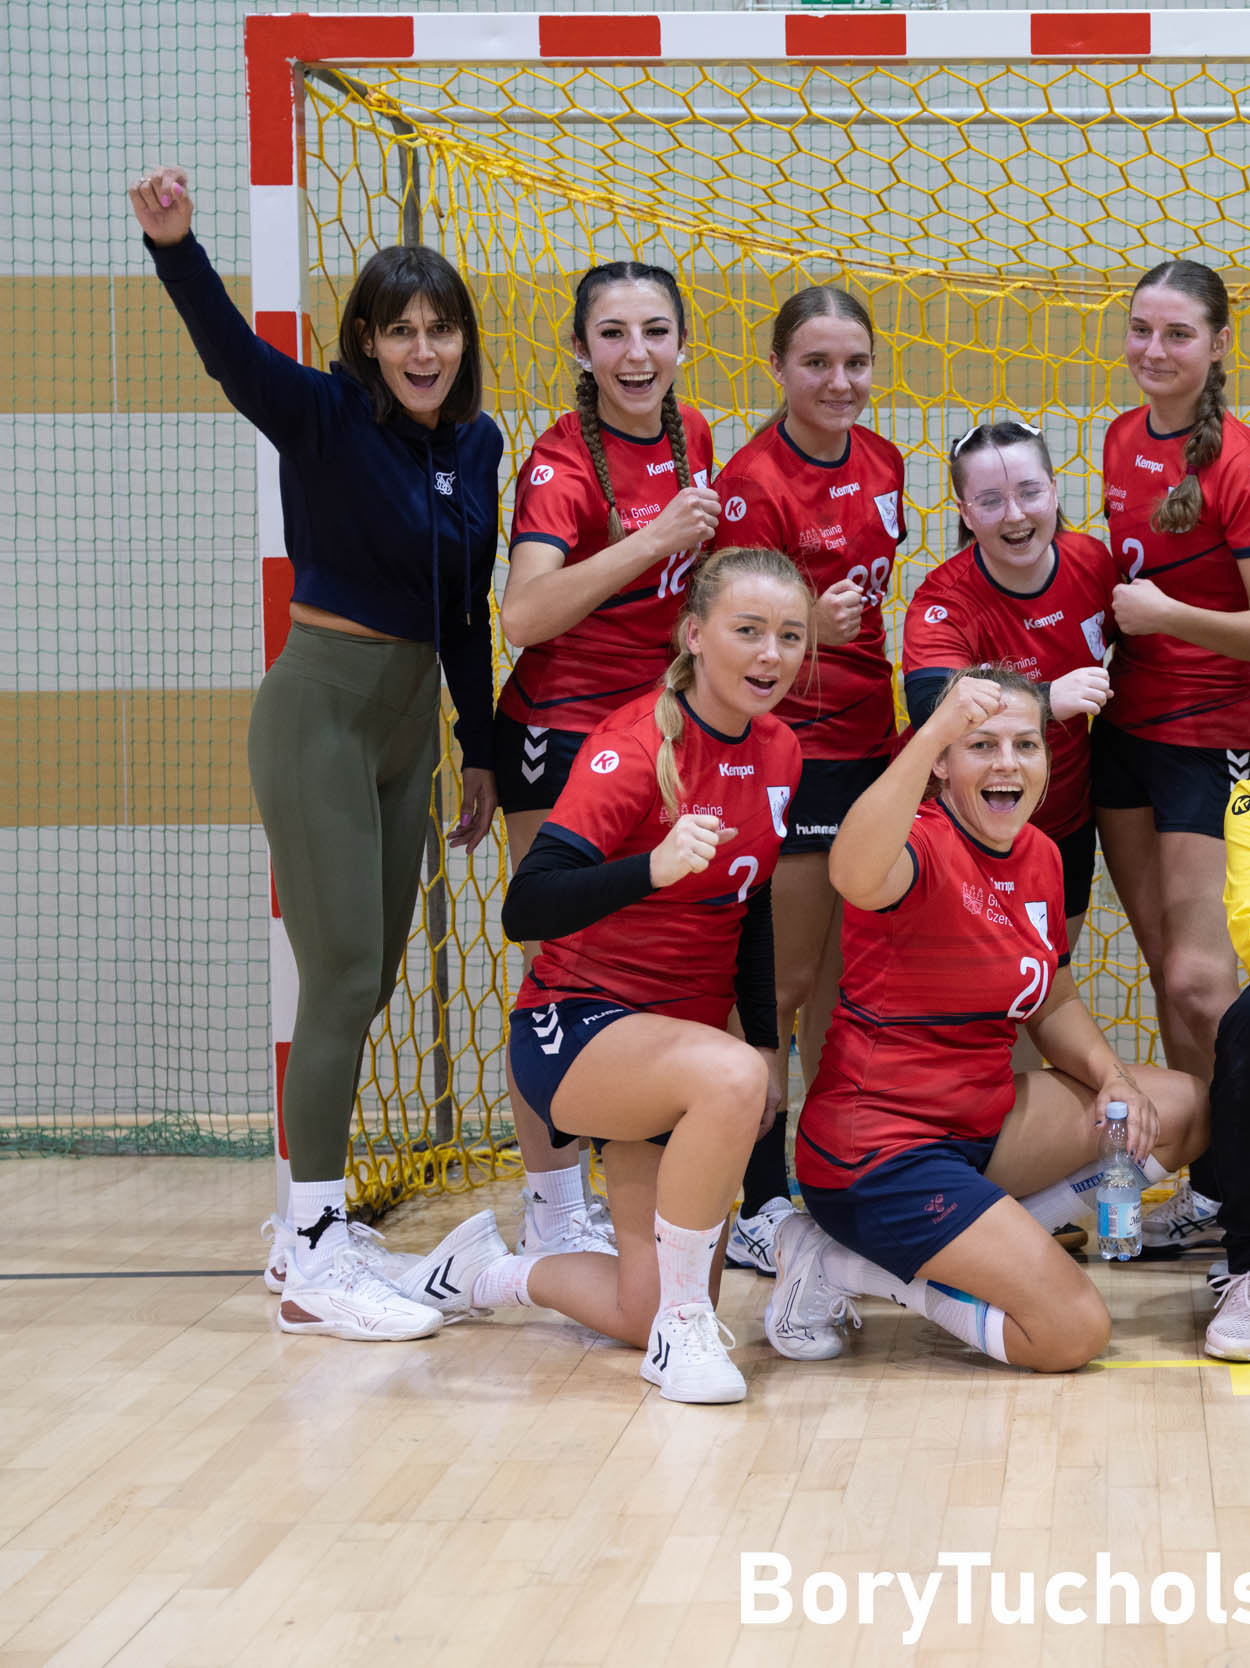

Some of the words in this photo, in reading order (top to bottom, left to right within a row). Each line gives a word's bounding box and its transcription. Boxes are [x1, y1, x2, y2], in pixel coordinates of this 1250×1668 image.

[646, 460, 675, 476] Kemp
[1135, 454, 1163, 474] Kempa
[829, 482, 861, 499] Kempa
[631, 503, 660, 519] Gmina
[1024, 610, 1064, 630] Kempa
[719, 763, 754, 779] Kempa
[693, 804, 722, 816] Gmina
[1007, 956, 1049, 1020] 21
